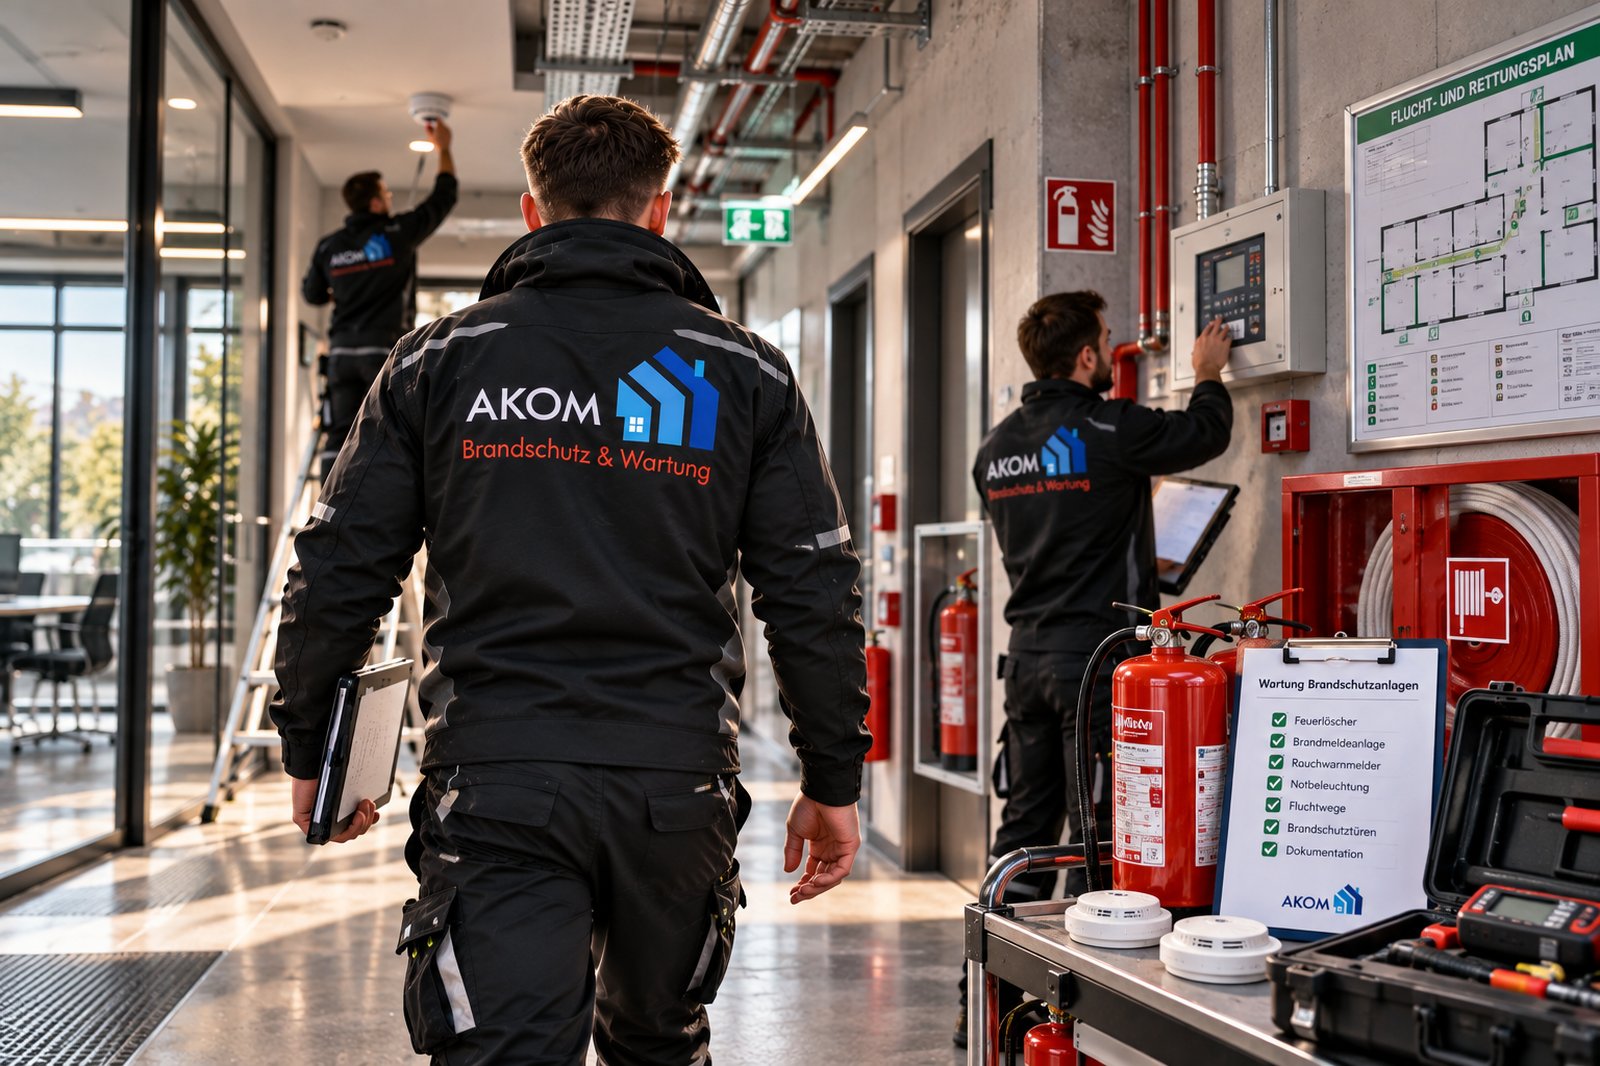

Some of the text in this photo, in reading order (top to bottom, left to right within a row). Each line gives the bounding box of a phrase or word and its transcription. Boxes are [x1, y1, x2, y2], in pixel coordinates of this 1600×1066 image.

[1391, 42, 1575, 125] FLUCHT- UND RETTUNGSPLAN
[465, 387, 601, 425] AKOM
[462, 436, 711, 486] Brandschutz & Wartung
[986, 453, 1040, 481] AKOM
[1045, 479, 1091, 492] Wartung
[1258, 678, 1419, 692] Wartung Brandschutzanlagen
[1294, 715, 1358, 727] Feuerlöscher
[1293, 737, 1386, 751] Brandmeldeanlage
[1291, 758, 1382, 771] Rauchwarnmelder
[1290, 779, 1370, 795] Notbeleuchtung
[1289, 800, 1347, 815] Fluchtwege
[1287, 822, 1377, 837] Brandschutztüren
[1285, 845, 1364, 859] Dokumentation
[1281, 895, 1330, 911] AKOM
